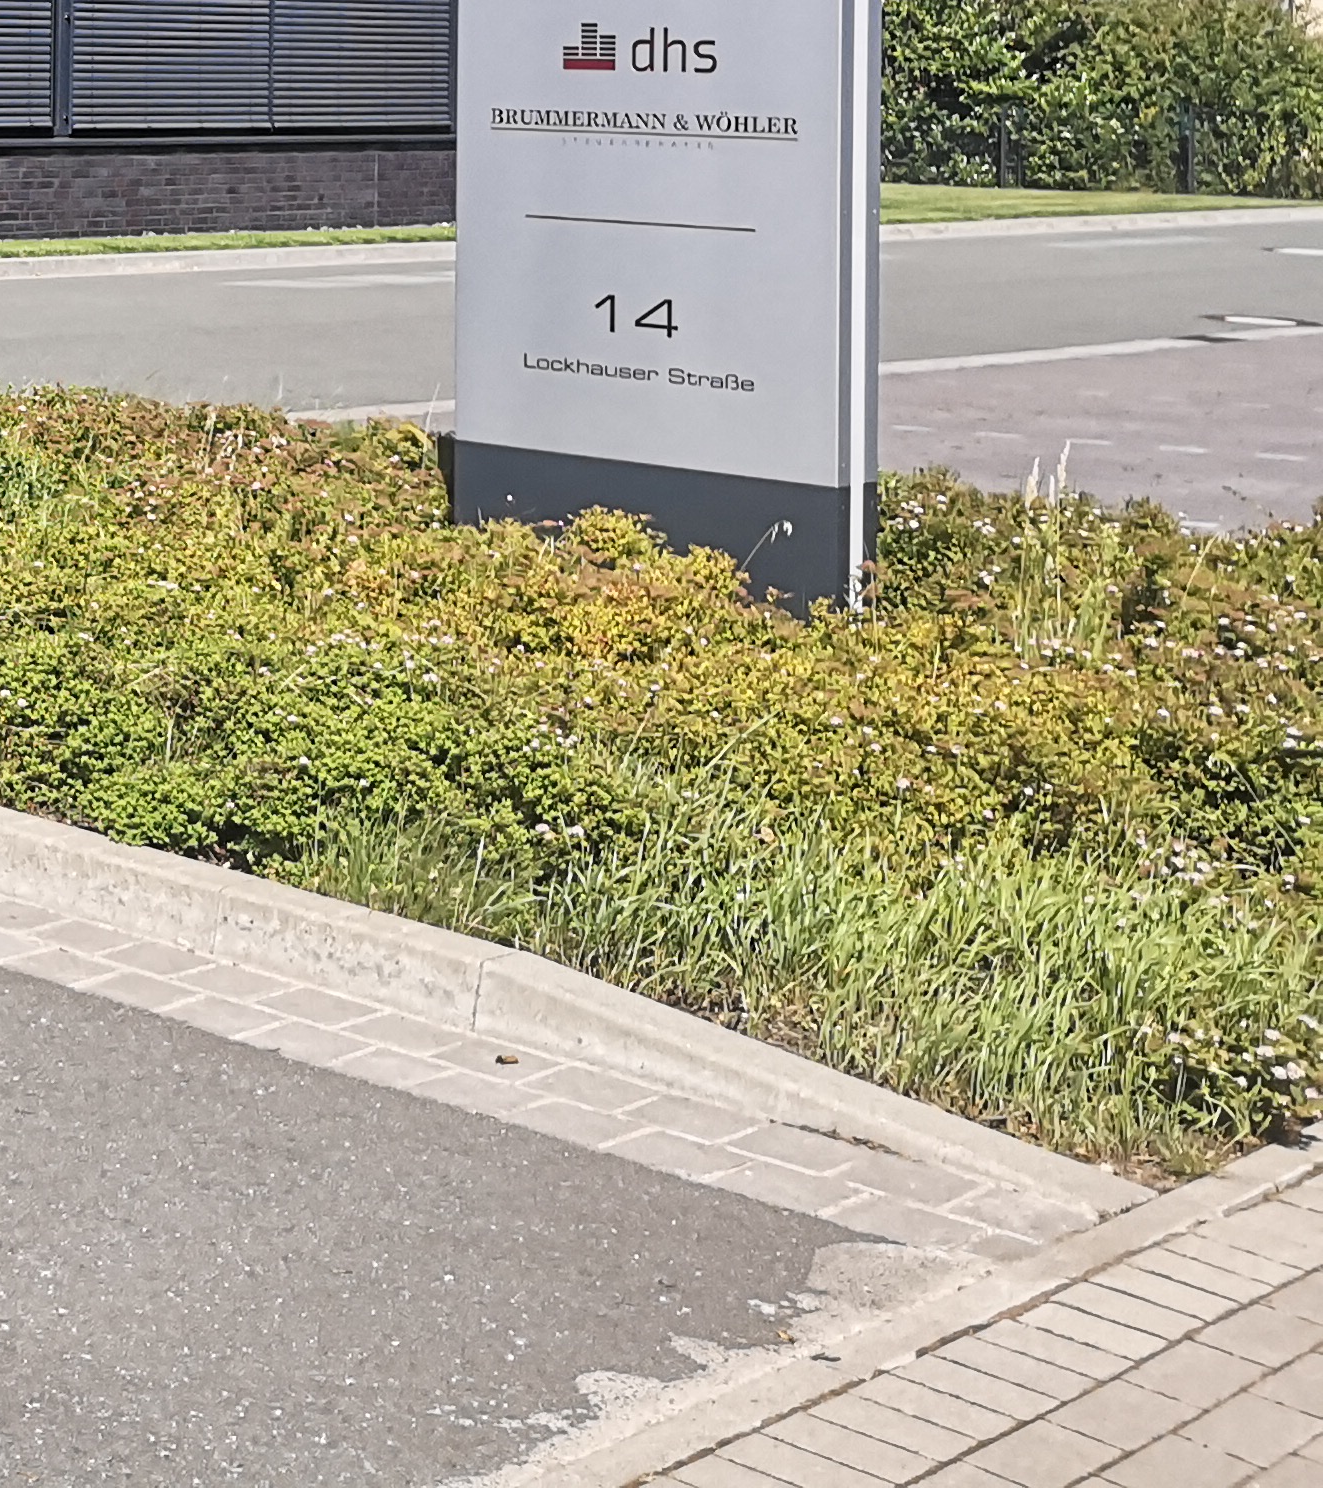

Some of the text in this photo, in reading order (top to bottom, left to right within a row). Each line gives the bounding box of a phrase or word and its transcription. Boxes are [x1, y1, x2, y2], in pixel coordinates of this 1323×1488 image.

[631, 27, 717, 73] dhs
[490, 107, 799, 135] BRUMMERMANN & WÖHLER
[594, 294, 679, 338] 14
[523, 353, 755, 392] Lockhauser Straße
